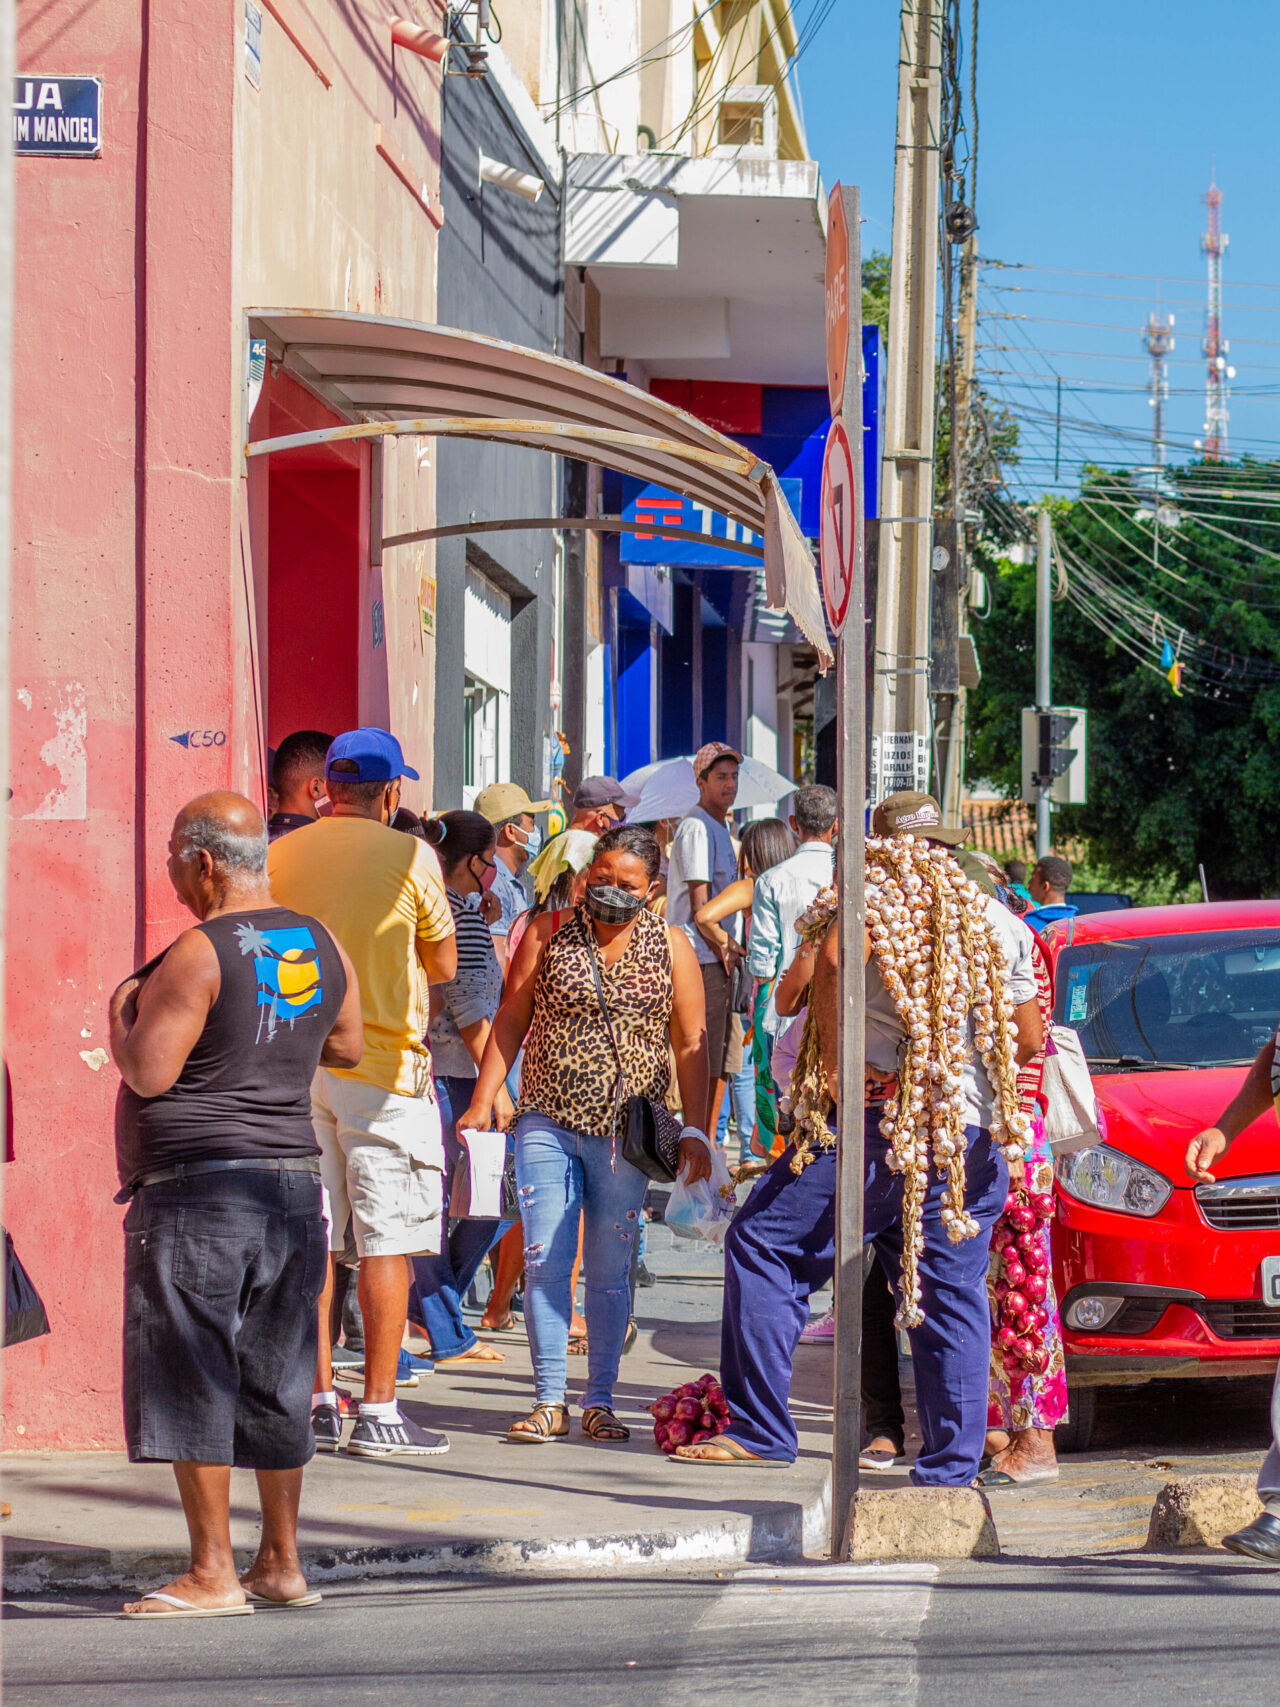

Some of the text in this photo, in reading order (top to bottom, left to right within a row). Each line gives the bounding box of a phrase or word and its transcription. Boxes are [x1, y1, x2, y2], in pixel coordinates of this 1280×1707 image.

[33, 116, 97, 143] MANOEL
[826, 264, 846, 332] PARE
[190, 730, 226, 748] C50
